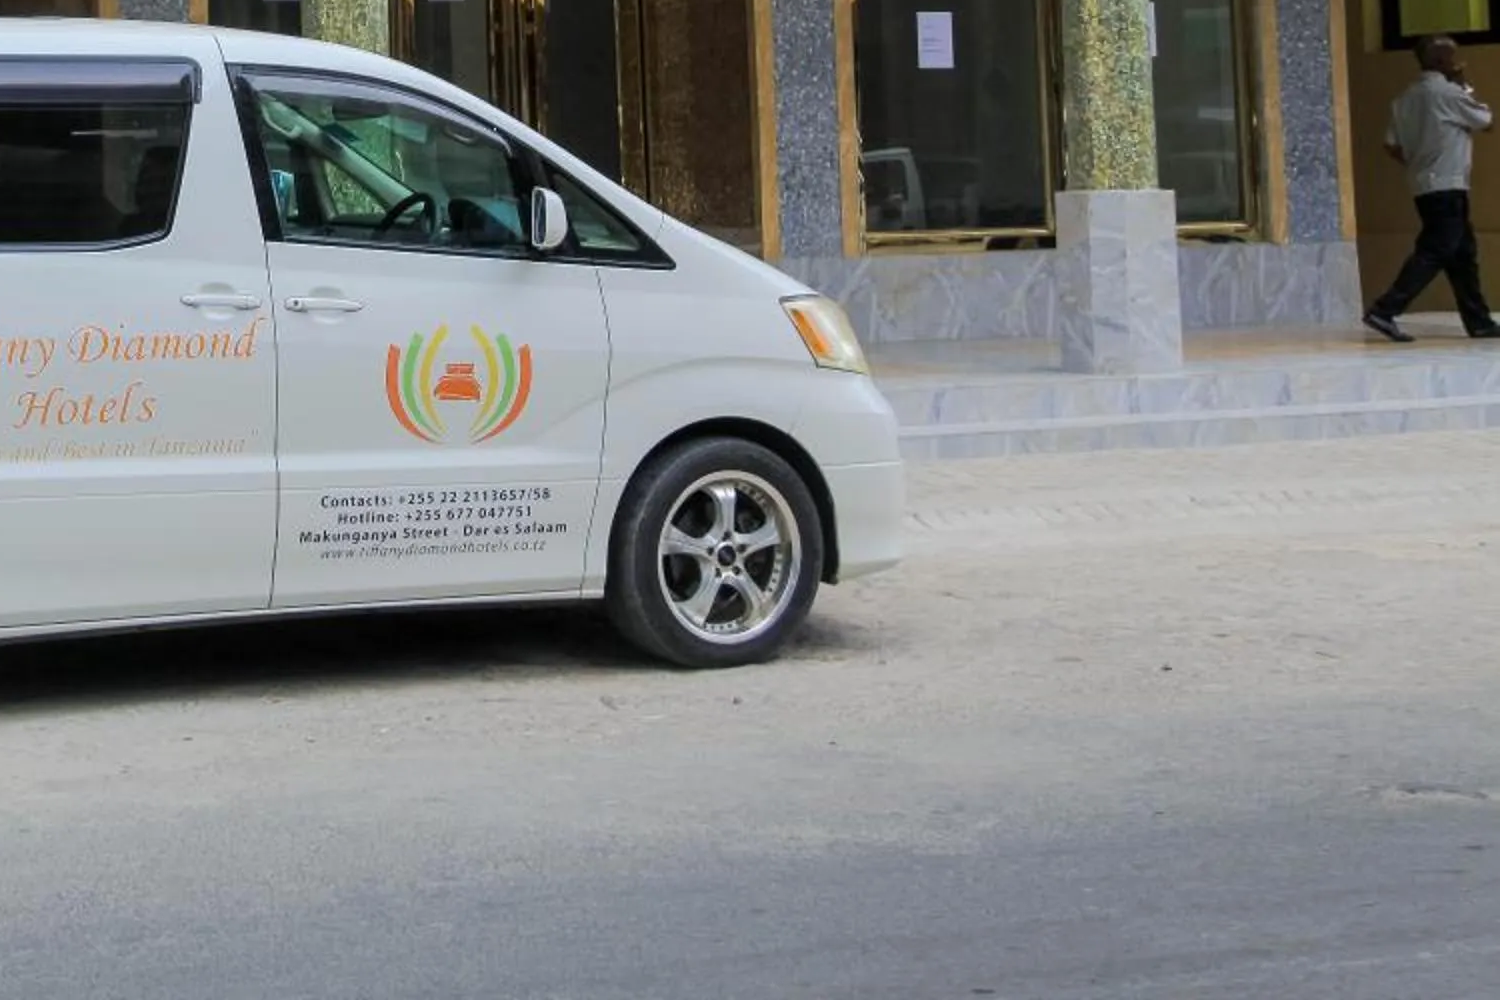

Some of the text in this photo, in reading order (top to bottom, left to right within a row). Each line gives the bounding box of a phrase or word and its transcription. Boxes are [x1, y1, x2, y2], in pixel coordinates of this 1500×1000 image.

[67, 317, 268, 364] Diamond
[12, 381, 159, 429] Hotels
[320, 493, 392, 509] Contacts:
[399, 491, 436, 506] +255
[337, 511, 400, 525] Hotline:
[404, 508, 442, 522] +255
[446, 507, 473, 520] 677
[299, 529, 398, 545] Makunganya
[402, 526, 449, 540] Street
[462, 524, 491, 537] Dar
[514, 521, 568, 536] Salaam
